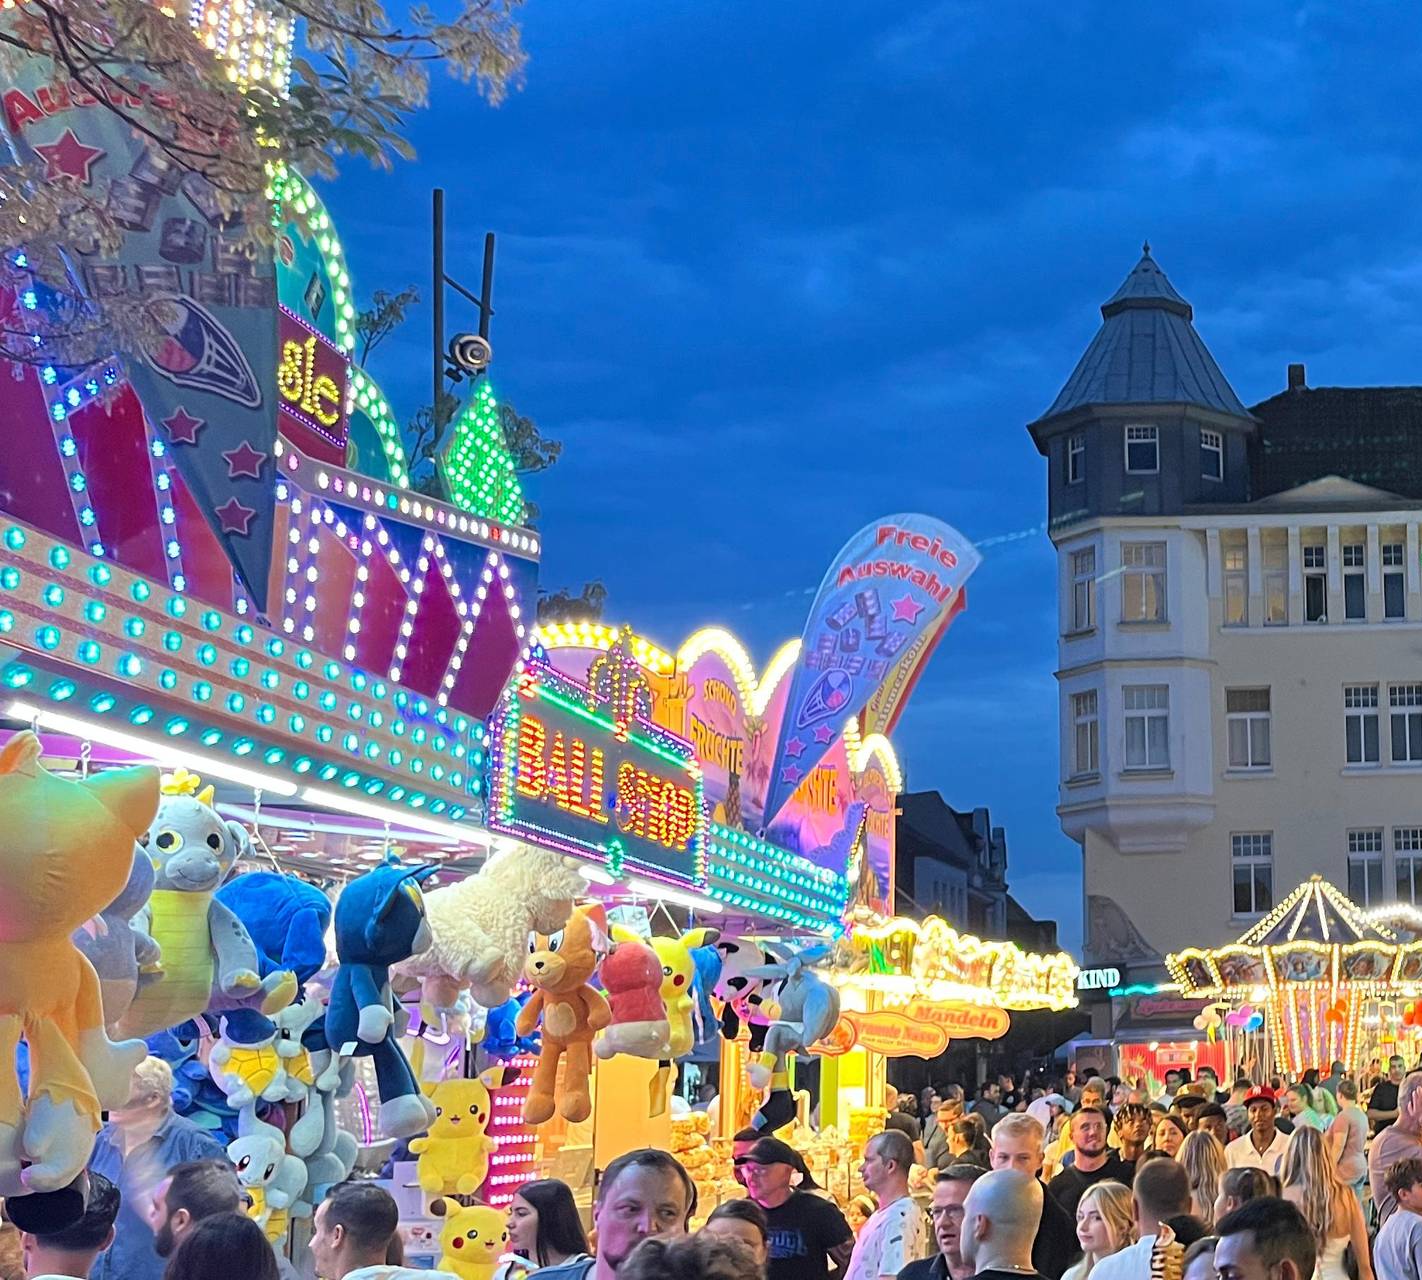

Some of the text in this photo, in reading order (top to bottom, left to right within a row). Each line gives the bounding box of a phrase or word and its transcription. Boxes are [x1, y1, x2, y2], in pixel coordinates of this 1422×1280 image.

[876, 525, 958, 568] Freie
[837, 559, 952, 602] Auswahl
[690, 712, 744, 775] FRÜCHTE
[516, 714, 609, 825] BALL
[1078, 968, 1121, 989] KIND
[914, 1005, 999, 1030] Mandeln
